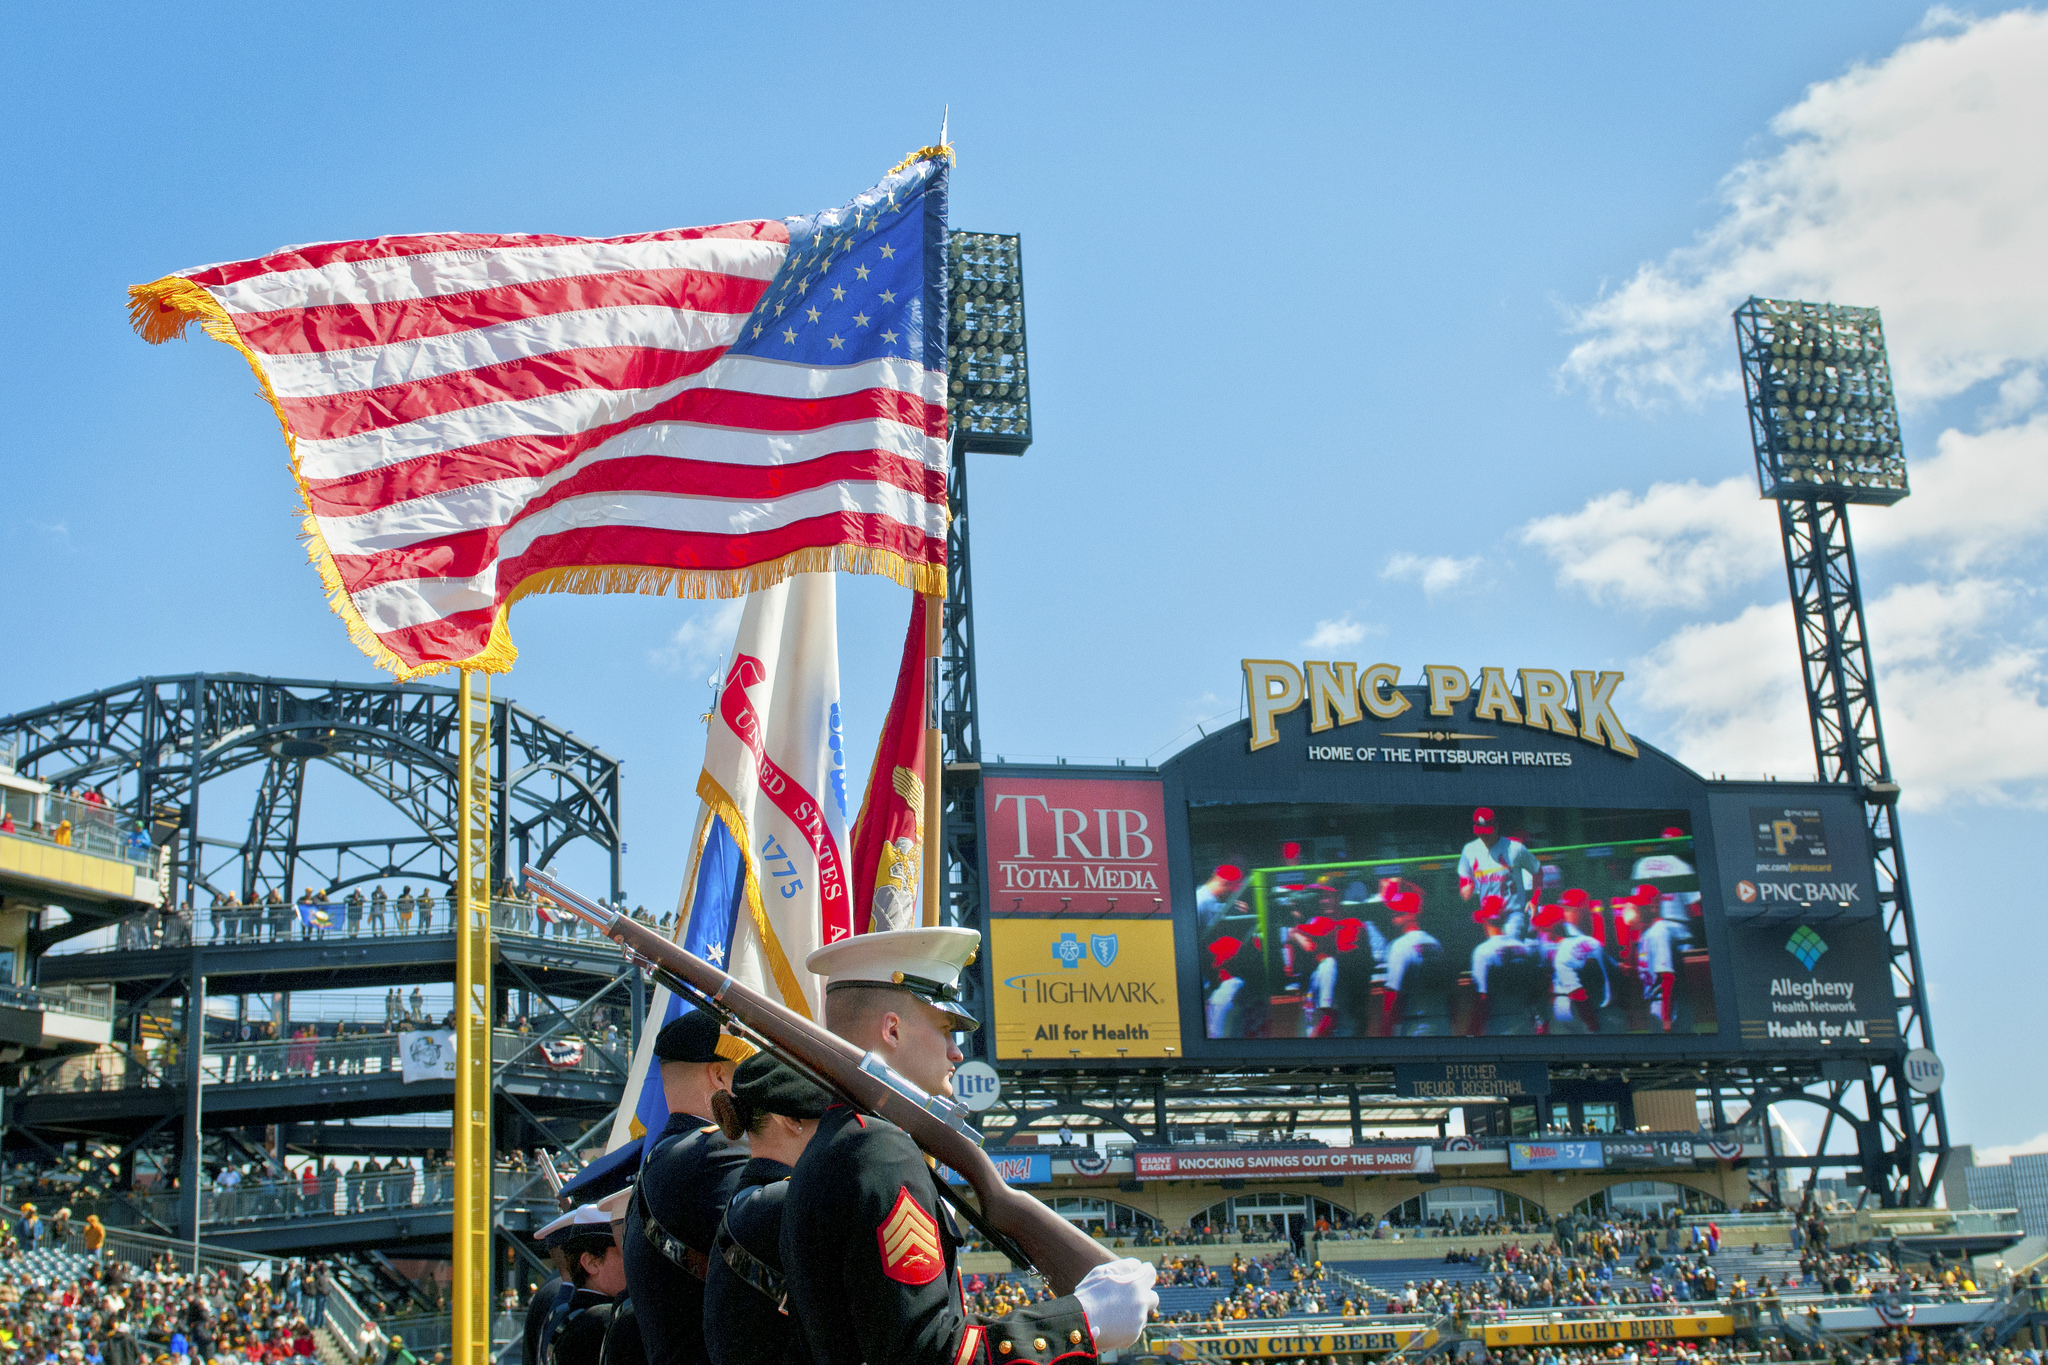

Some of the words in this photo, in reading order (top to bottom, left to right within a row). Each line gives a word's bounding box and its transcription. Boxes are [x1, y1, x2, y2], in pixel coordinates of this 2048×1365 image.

[1242, 658, 1412, 752] PNC
[1424, 664, 1639, 759] PARK
[1308, 745, 1354, 761] HOME
[1356, 747, 1377, 761] OF
[1381, 747, 1412, 763] THE
[1414, 748, 1509, 764] PITTSBURGH
[1512, 750, 1573, 766] PIRATES
[994, 794, 1153, 860] TRIB
[794, 801, 843, 901] STATES
[1808, 847, 1827, 856] VISA
[761, 834, 804, 899] 1775
[999, 864, 1079, 889] TOTAL
[1083, 866, 1159, 890] MEDIA
[1021, 978, 1159, 1005] HIGHMARK
[1770, 978, 1854, 1000] Allegheny
[1772, 1001, 1809, 1013] Health
[1810, 1001, 1857, 1013] Network
[1034, 1023, 1059, 1041] All
[1064, 1023, 1088, 1041] for
[1092, 1023, 1149, 1041] Health
[1767, 1020, 1818, 1038] Health
[1820, 1020, 1842, 1037] for
[1844, 1019, 1866, 1037] All
[1446, 1064, 1497, 1080] PITCHER
[1909, 1059, 1940, 1082] Lite
[957, 1074, 996, 1099] Lite
[1412, 1080, 1456, 1097] TREVOR
[1462, 1080, 1527, 1096] ROSENTHAL
[1140, 1156, 1172, 1164] GIANT
[1178, 1157, 1245, 1170] KNOCKING
[1247, 1155, 1300, 1168] SAVINGS
[1302, 1155, 1328, 1167] OUT
[1330, 1154, 1348, 1166] OF
[1350, 1153, 1374, 1165] THE
[1376, 1152, 1412, 1165] PARK!
[1531, 1324, 1551, 1343] IC
[1556, 1321, 1622, 1342] LIGHT
[1629, 1319, 1676, 1339] BEER
[1196, 1337, 1260, 1357] IRON
[1268, 1335, 1325, 1355] CITY
[1330, 1332, 1398, 1351] BEER
